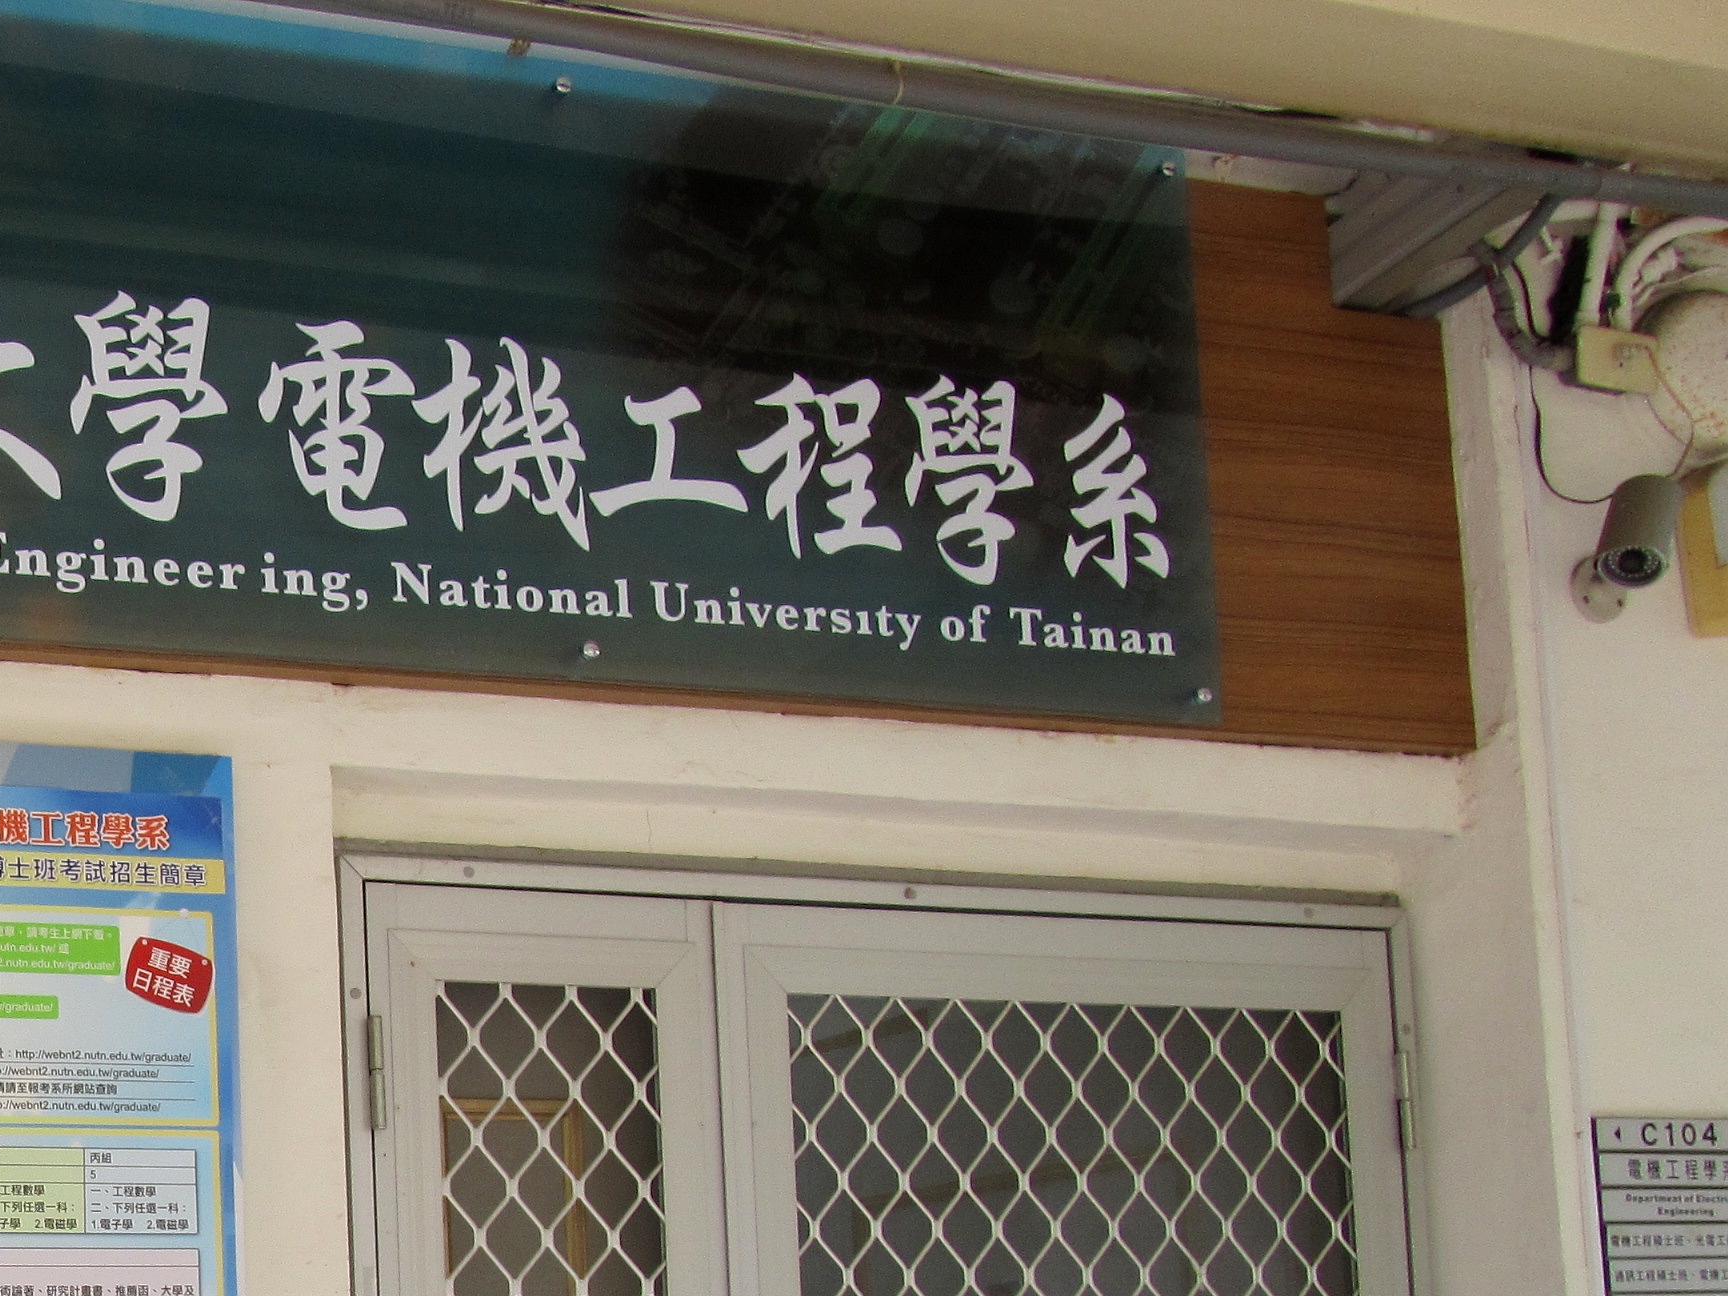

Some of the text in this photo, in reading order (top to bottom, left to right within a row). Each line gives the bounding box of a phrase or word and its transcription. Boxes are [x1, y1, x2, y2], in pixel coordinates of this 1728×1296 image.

[393, 562, 632, 618] National
[652, 581, 920, 652] University
[941, 604, 988, 645] of
[1010, 607, 1175, 656] Tainan
[148, 947, 192, 979] 重要
[132, 968, 195, 1008] 日程表
[1641, 1122, 1717, 1146] C104
[90, 1152, 112, 1163] 丙組
[90, 1170, 96, 1179] 5
